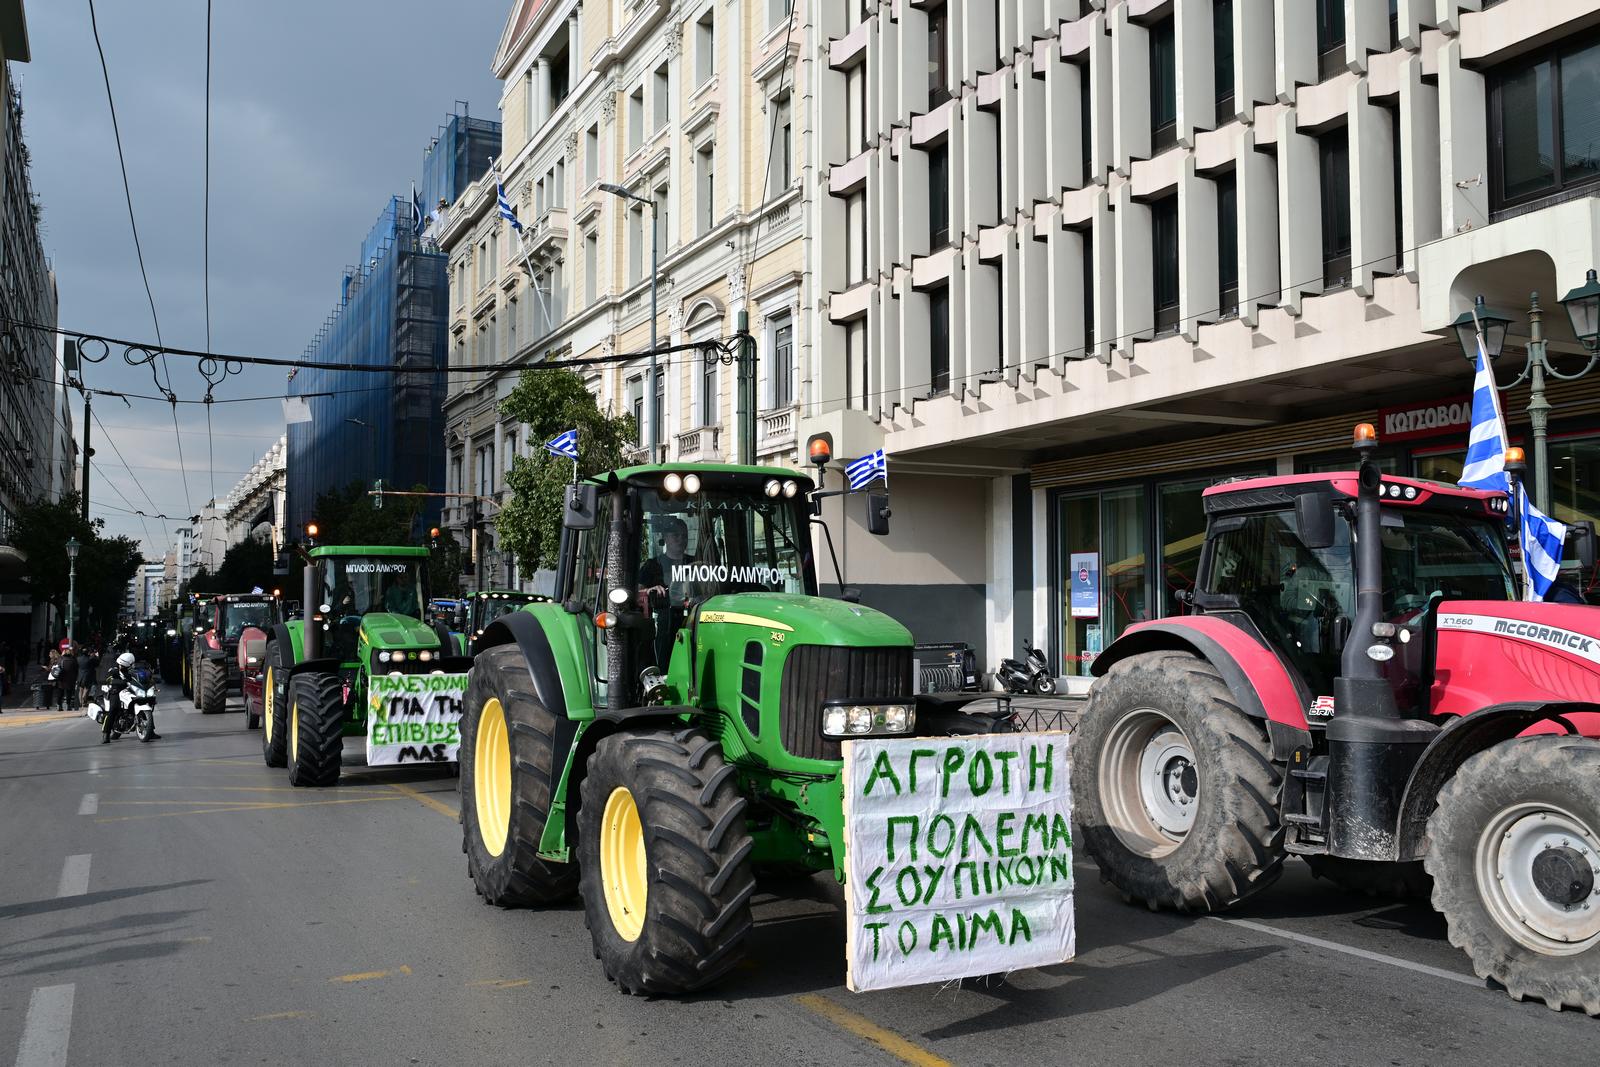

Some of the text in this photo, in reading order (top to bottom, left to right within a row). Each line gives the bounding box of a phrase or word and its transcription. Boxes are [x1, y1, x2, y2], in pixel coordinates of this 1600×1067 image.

[346, 564, 407, 573] ΜΠΛΟΚΟ ΑΛΜΥΡΟΥ
[671, 565, 784, 585] ΜΠΛΟΚΟ ΑΛΜΥΡΟΥ
[1443, 617, 1474, 626] X7.660
[770, 631, 785, 643] 7430
[390, 696, 424, 716] ΓΙΑ
[398, 744, 449, 762] ΜΑΣ
[863, 743, 1054, 798] ΑΓΡΟΤΗ
[886, 812, 1073, 863] ΠΟΛΕΜΑ
[865, 853, 1068, 914] ΣΟΥ ΠΙΝΟΥΝ
[863, 908, 1033, 963] ΤΟ ΑΙΜΑ
